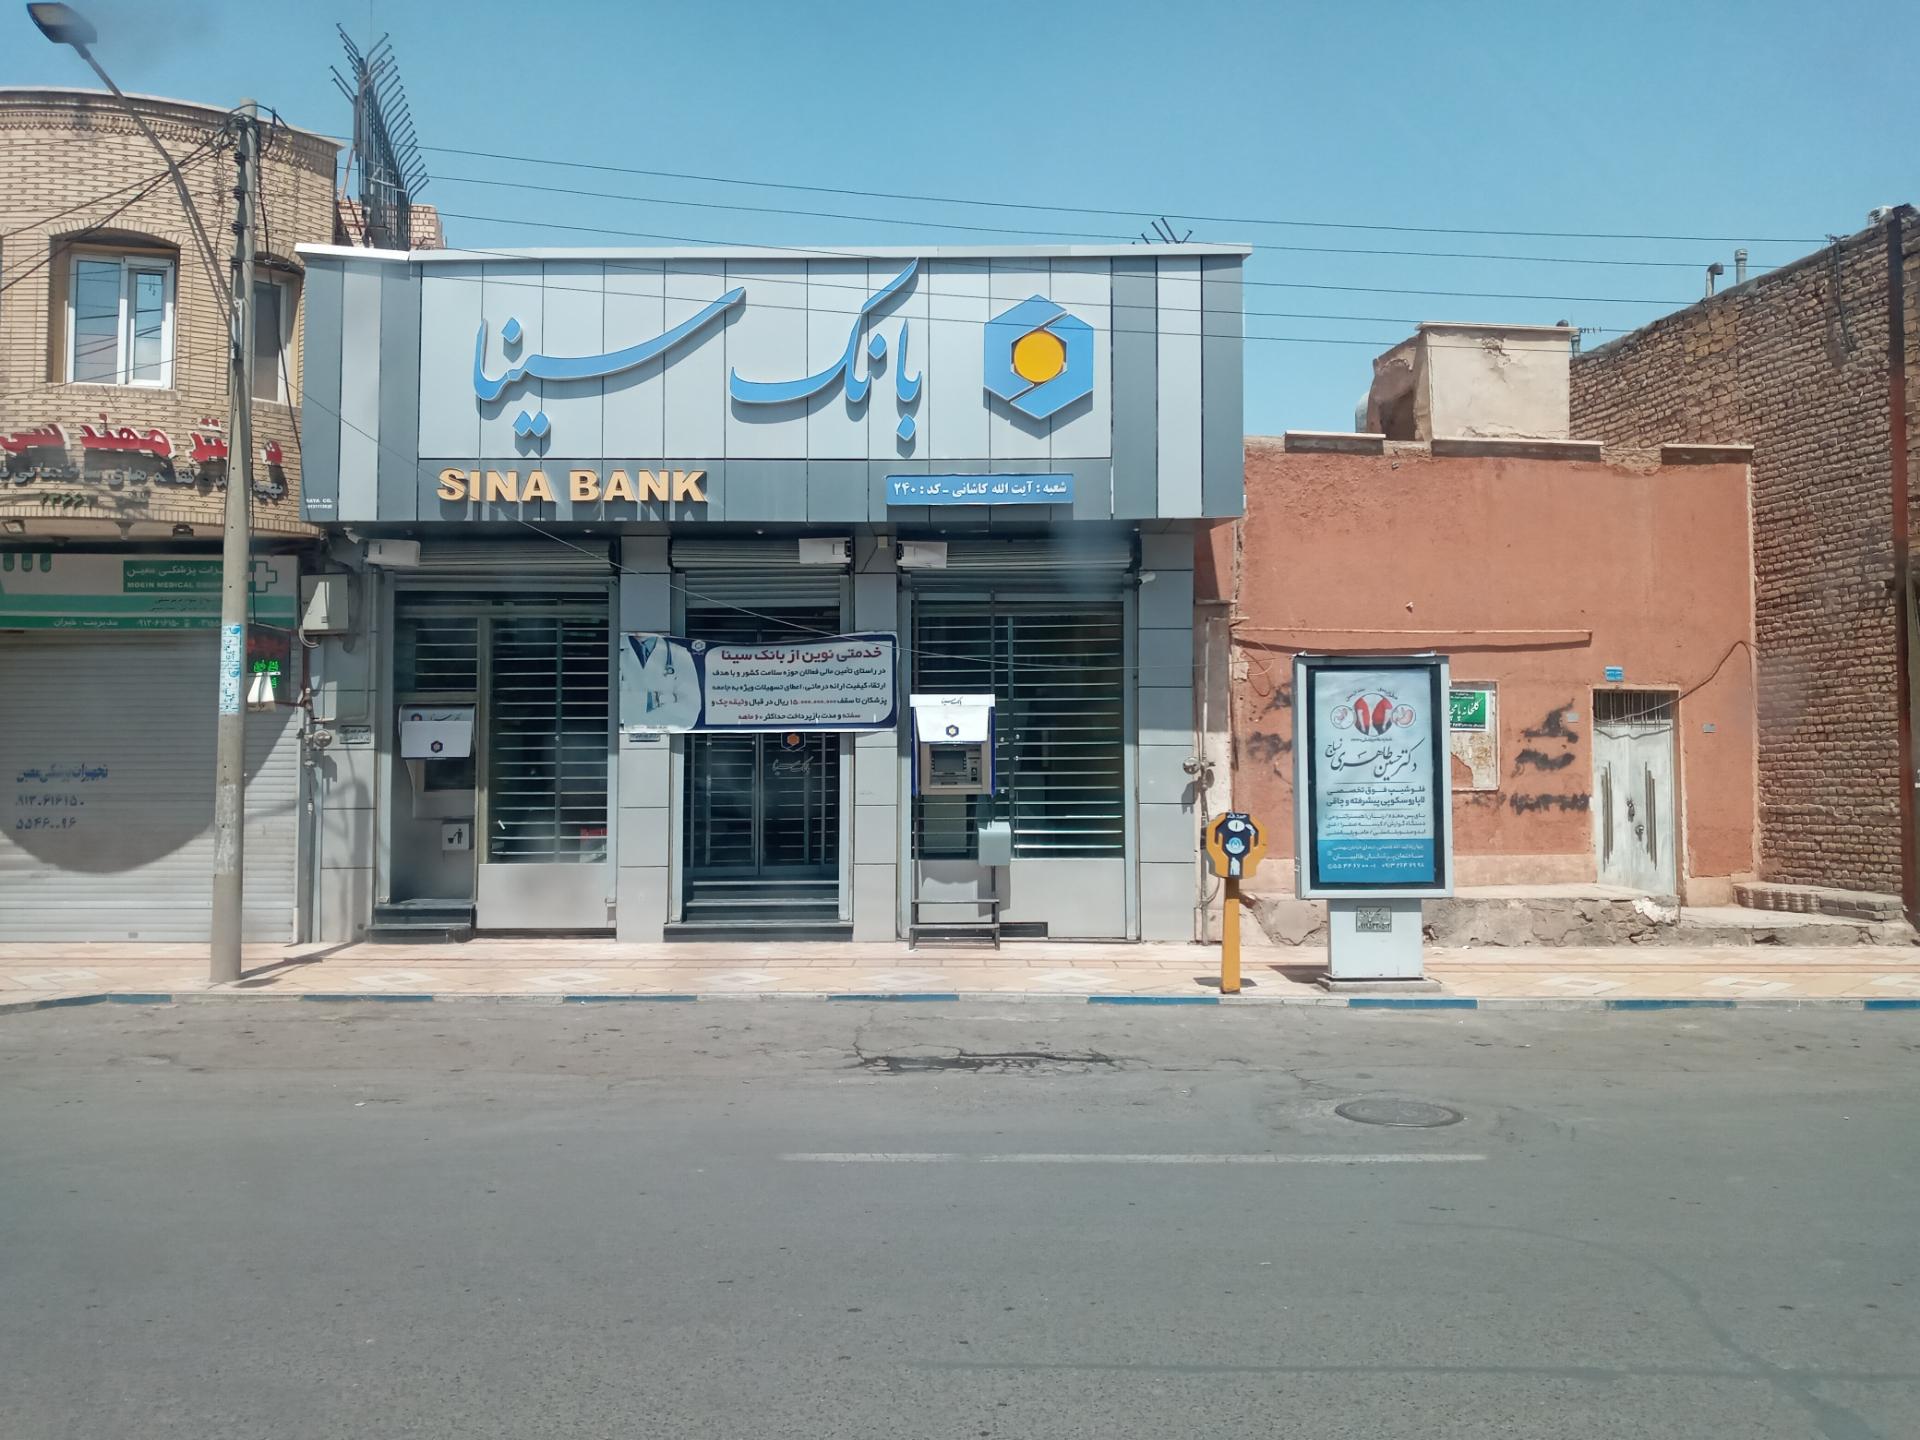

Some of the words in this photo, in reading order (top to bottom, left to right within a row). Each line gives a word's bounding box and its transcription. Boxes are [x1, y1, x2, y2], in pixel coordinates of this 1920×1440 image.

[730, 258, 921, 441] بانک
[474, 286, 746, 438] سینا
[437, 468, 556, 502] SINA
[569, 468, 708, 502] BANK
[894, 482, 916, 495] ۲۴۰
[926, 482, 941, 494] کد
[952, 482, 988, 498] کاشانی
[991, 482, 1009, 494] الله
[1011, 480, 1033, 497] آیت
[1043, 481, 1067, 493] شعبه
[721, 650, 753, 664] سینا
[754, 650, 785, 664] بانک
[787, 650, 800, 664] از
[802, 649, 834, 663] نوین
[836, 647, 882, 662] خدمتی
[741, 669, 760, 677] کشور
[854, 668, 876, 676] راستای
[878, 668, 886, 677] در
[862, 697, 888, 706] پزشکان
[1331, 745, 1393, 772] طاهری
[1391, 737, 1425, 777] دکتر
[1374, 754, 1402, 781] حسین
[1326, 787, 1364, 796] تخصصی
[1365, 786, 1387, 795] فوق
[1387, 785, 1426, 796] فلوشیپ
